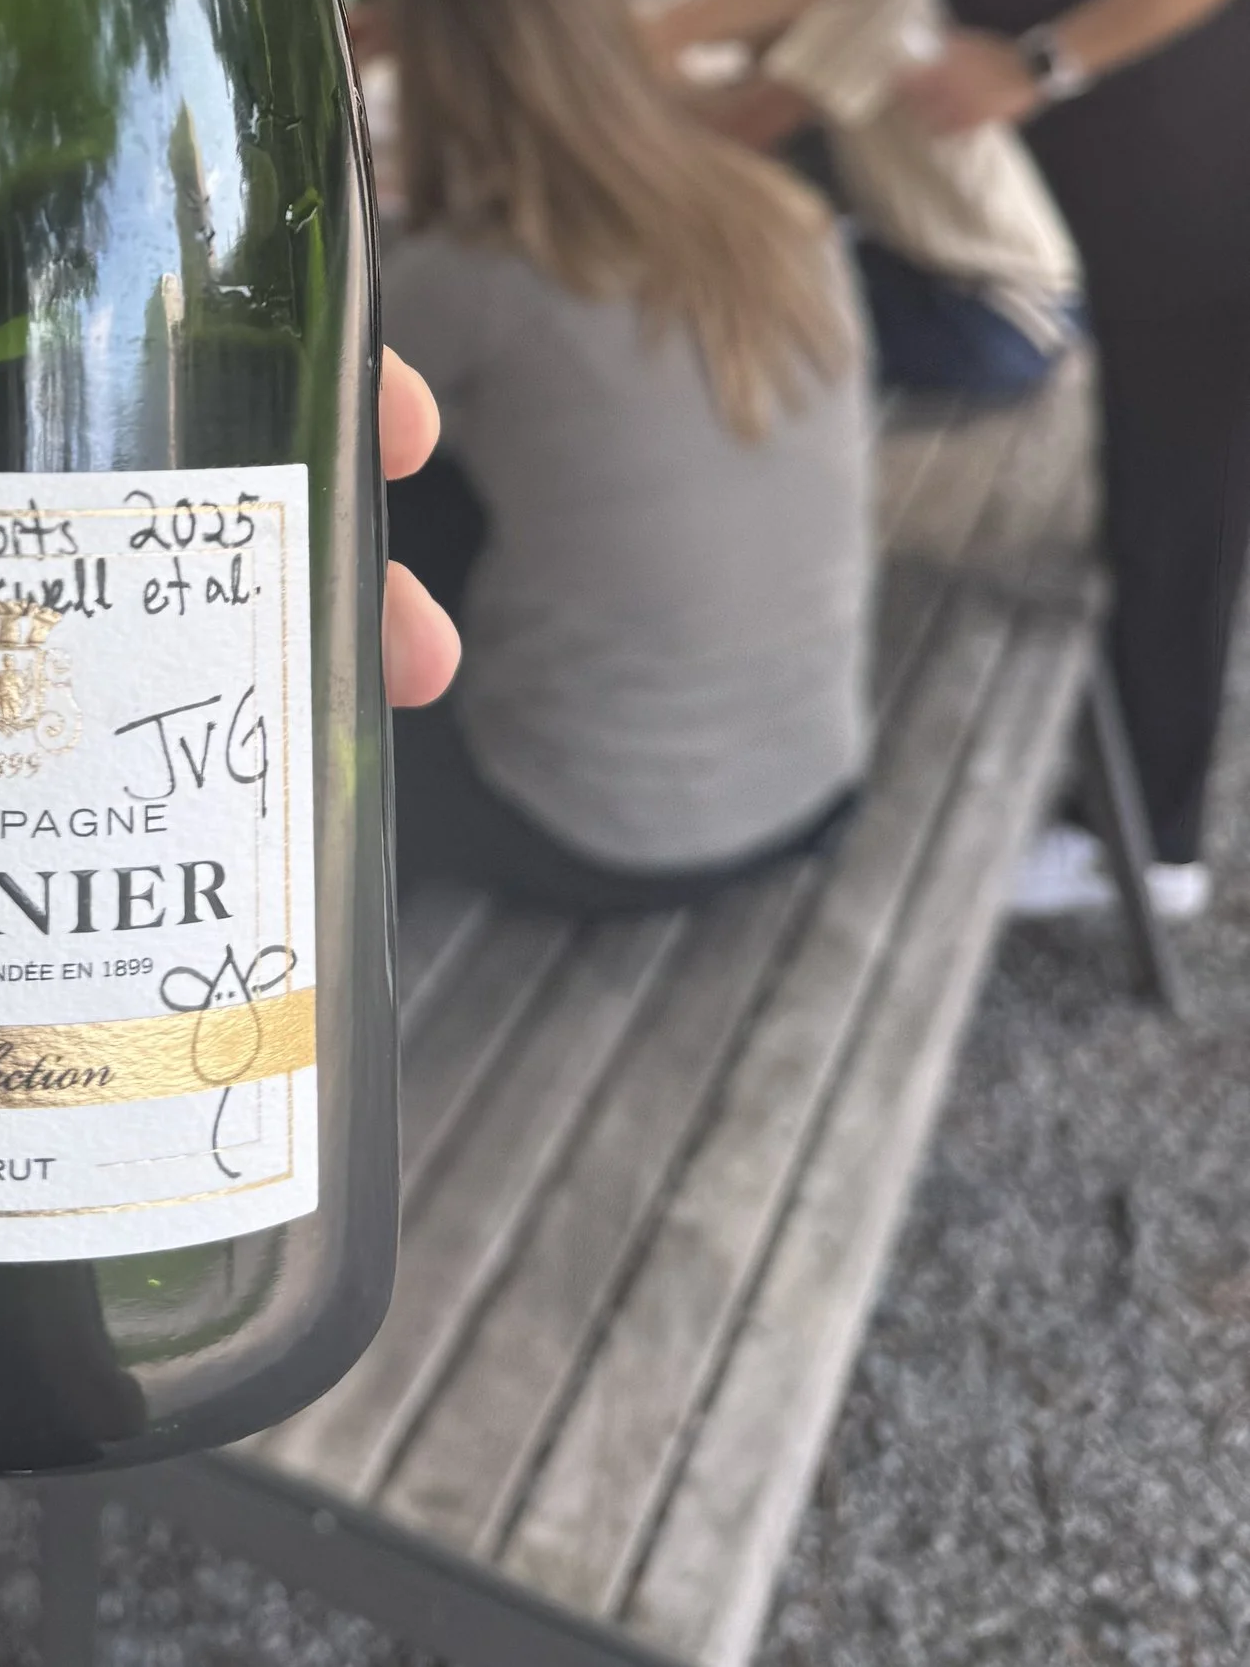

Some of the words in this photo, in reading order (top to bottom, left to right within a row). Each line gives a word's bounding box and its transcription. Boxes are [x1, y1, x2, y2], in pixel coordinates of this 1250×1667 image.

[122, 489, 262, 550] 2025
[143, 556, 191, 616] et
[205, 552, 261, 606] al.
[62, 961, 93, 980] EN
[102, 957, 154, 978] 1899
